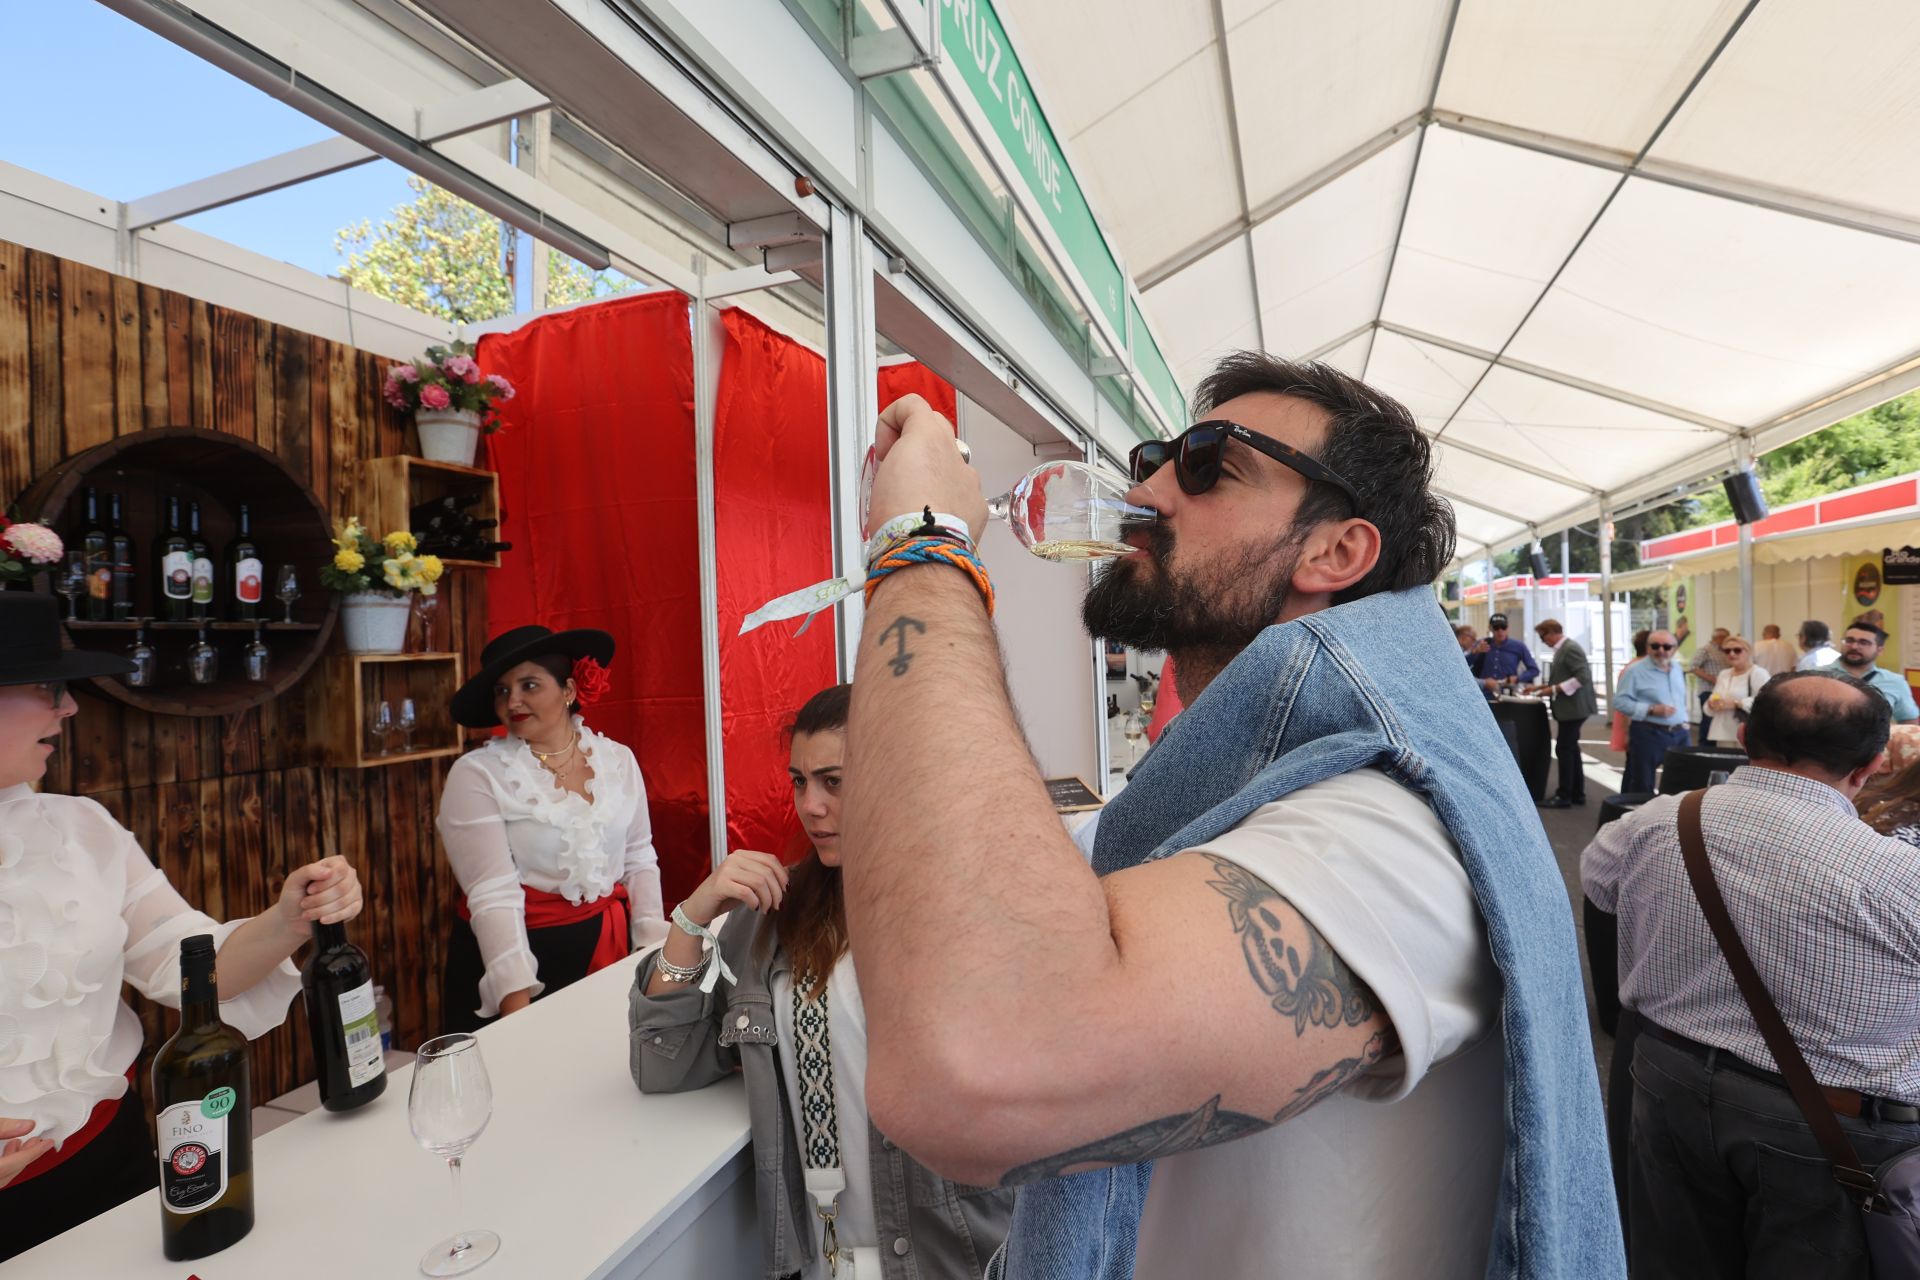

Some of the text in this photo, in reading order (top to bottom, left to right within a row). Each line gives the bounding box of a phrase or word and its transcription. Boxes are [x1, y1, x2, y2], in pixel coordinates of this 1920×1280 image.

[944, 0, 1062, 214] RUZ CONDE
[210, 1096, 230, 1111] 90
[172, 1123, 203, 1137] FINO
